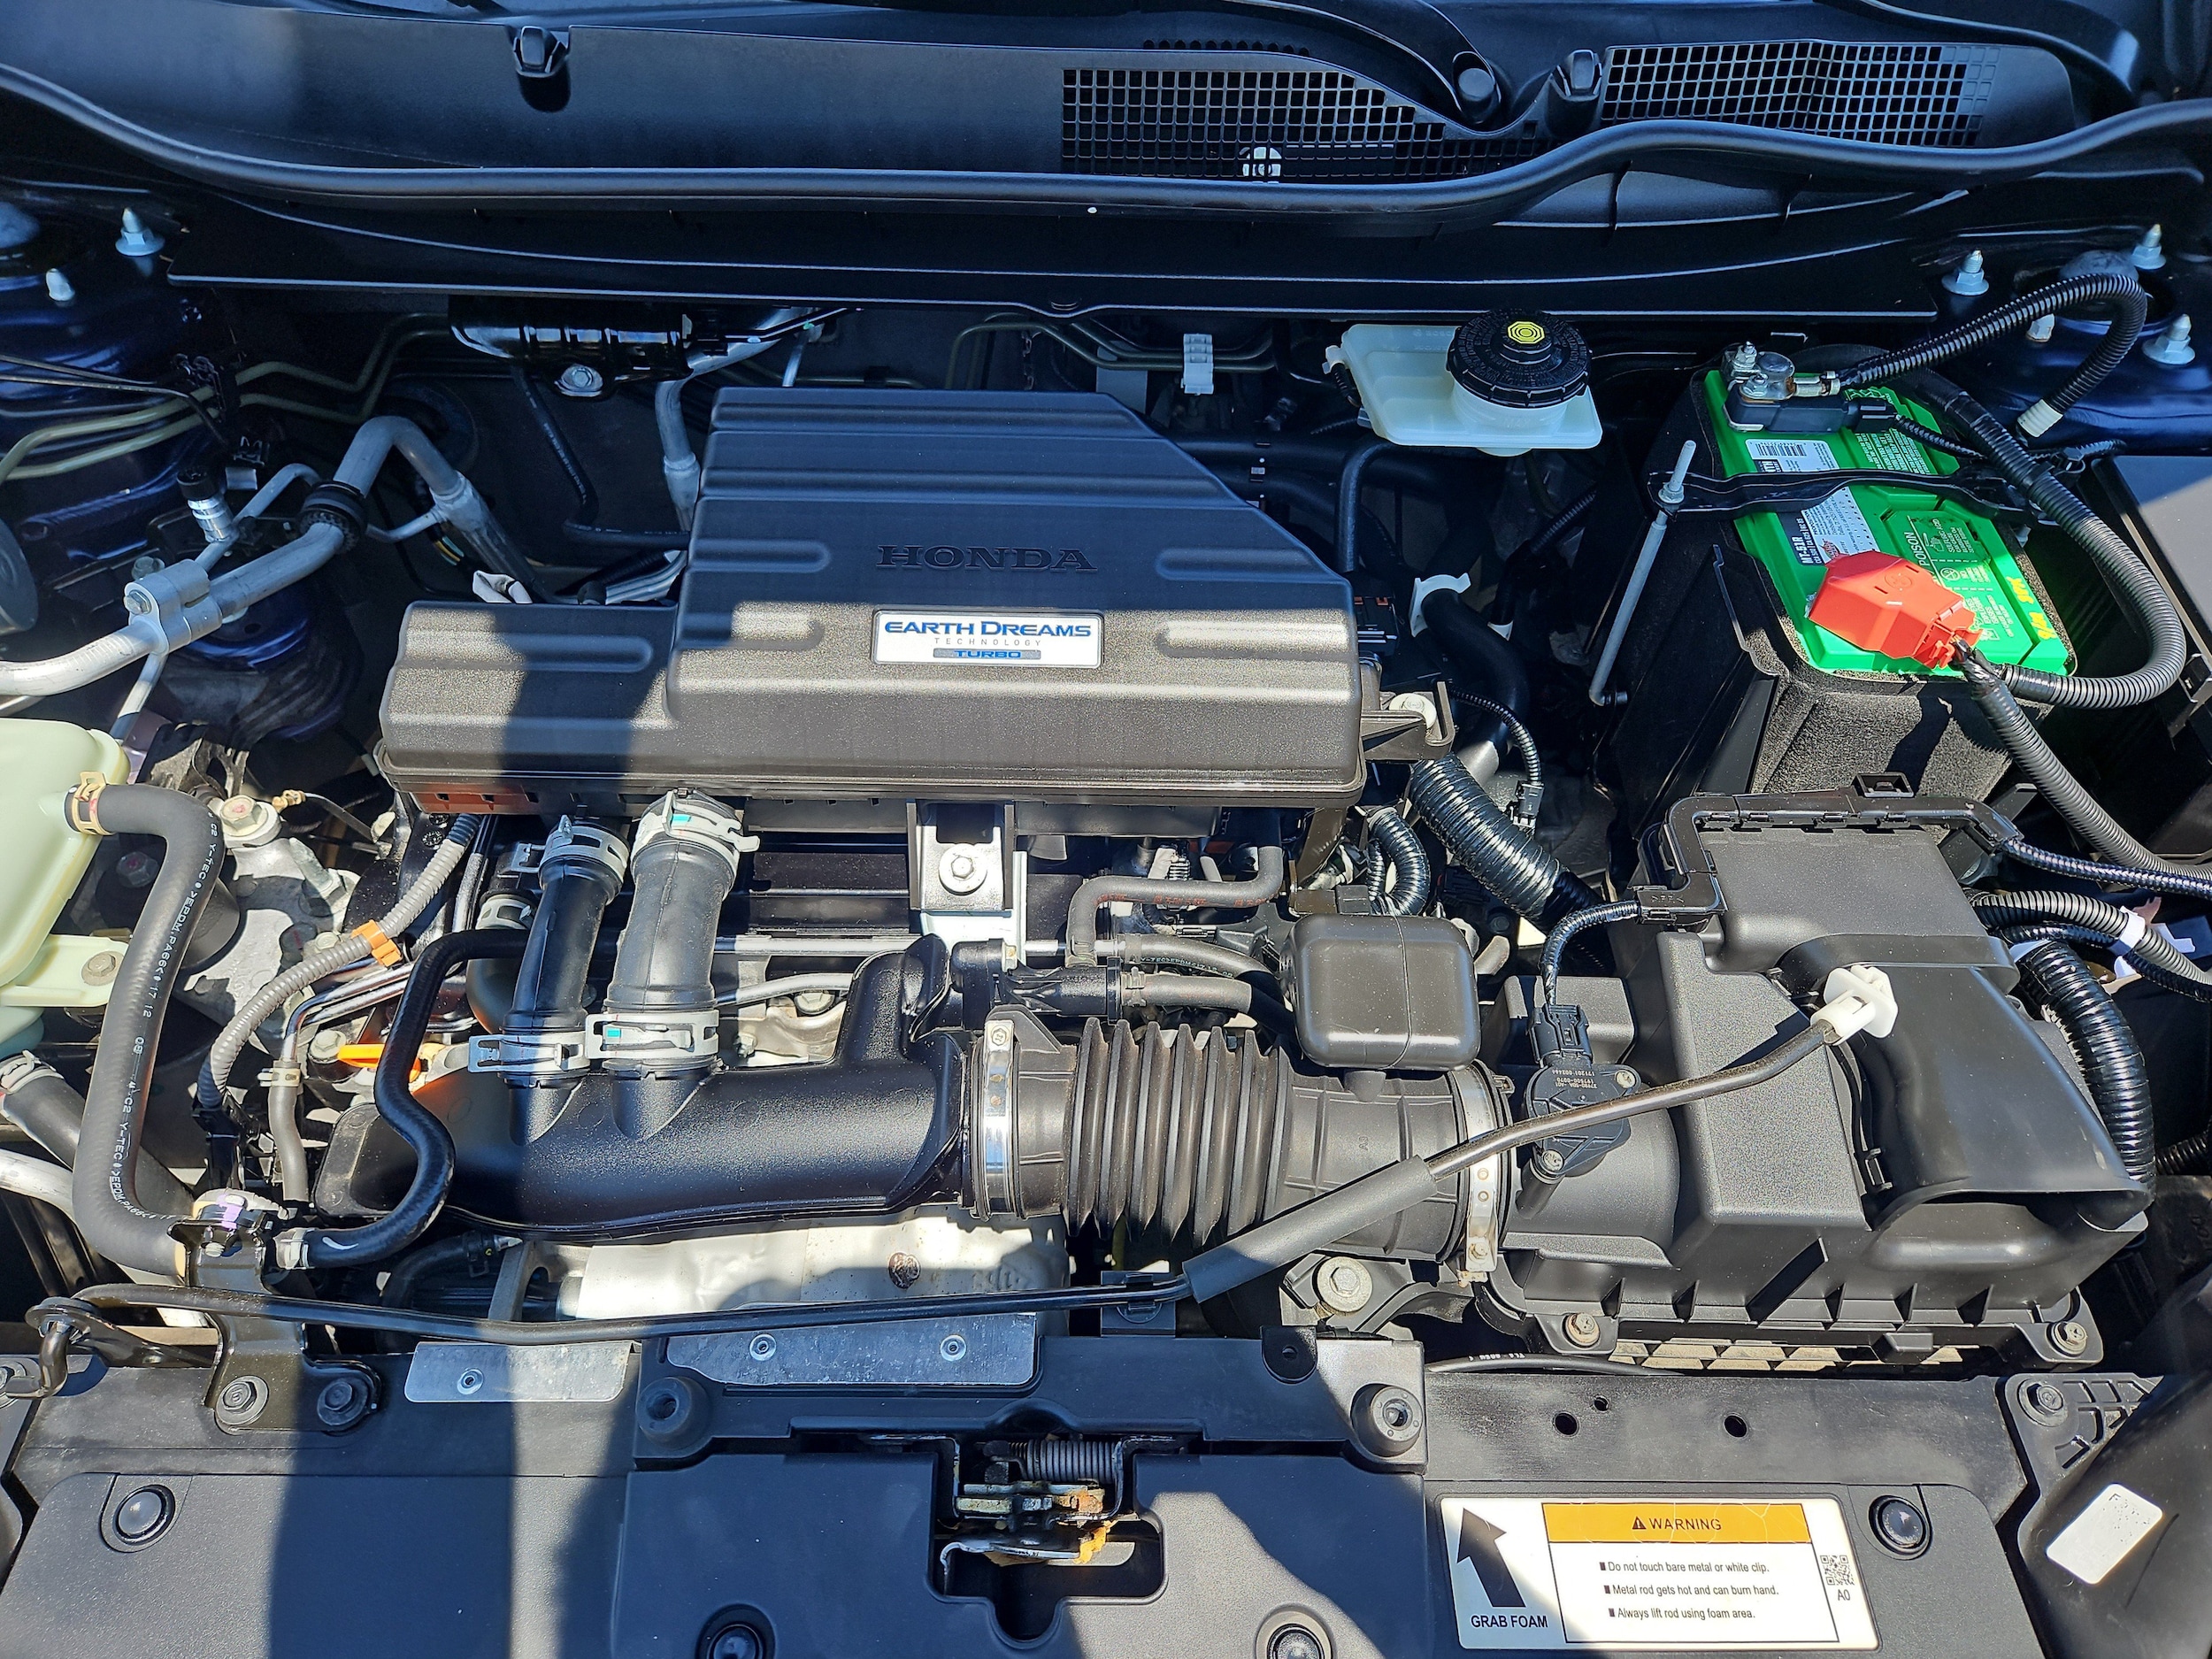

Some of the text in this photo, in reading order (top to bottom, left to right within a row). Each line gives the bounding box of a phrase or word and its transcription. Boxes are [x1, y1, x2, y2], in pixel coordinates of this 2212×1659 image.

[1791, 536, 1813, 564] MT-51R
[1903, 532, 1931, 566] POISON
[876, 545, 1098, 572] HONDA
[885, 621, 974, 635] EARTH
[934, 637, 1041, 646] TECHNOLOGY
[955, 649, 1022, 658] TURBO
[198, 843, 217, 881] Y-TEC
[122, 1097, 134, 1114] C2
[113, 1122, 129, 1161] Y-TEC
[1648, 1517, 1722, 1531] WARNING
[1608, 1562, 1621, 1571] Do
[1640, 1563, 1663, 1571] touch
[1665, 1563, 1686, 1571] bare
[1688, 1563, 1712, 1571] metal
[1725, 1563, 1748, 1571] white
[1752, 1563, 1769, 1574] clip.
[1613, 1585, 1637, 1594] Metal
[1640, 1586, 1654, 1594] rod
[1656, 1586, 1675, 1596] gets
[1678, 1586, 1692, 1594] hot
[1694, 1586, 1710, 1594] and
[1731, 1586, 1751, 1594] burn
[1754, 1586, 1779, 1594] hand.
[1838, 1589, 1850, 1601] A0
[1618, 1608, 1648, 1620] Always
[1651, 1609, 1663, 1617] lift
[1664, 1609, 1678, 1617] rod
[1681, 1609, 1705, 1620] using
[1708, 1609, 1730, 1617] foam
[1471, 1615, 1548, 1628] GRAB FOAM
